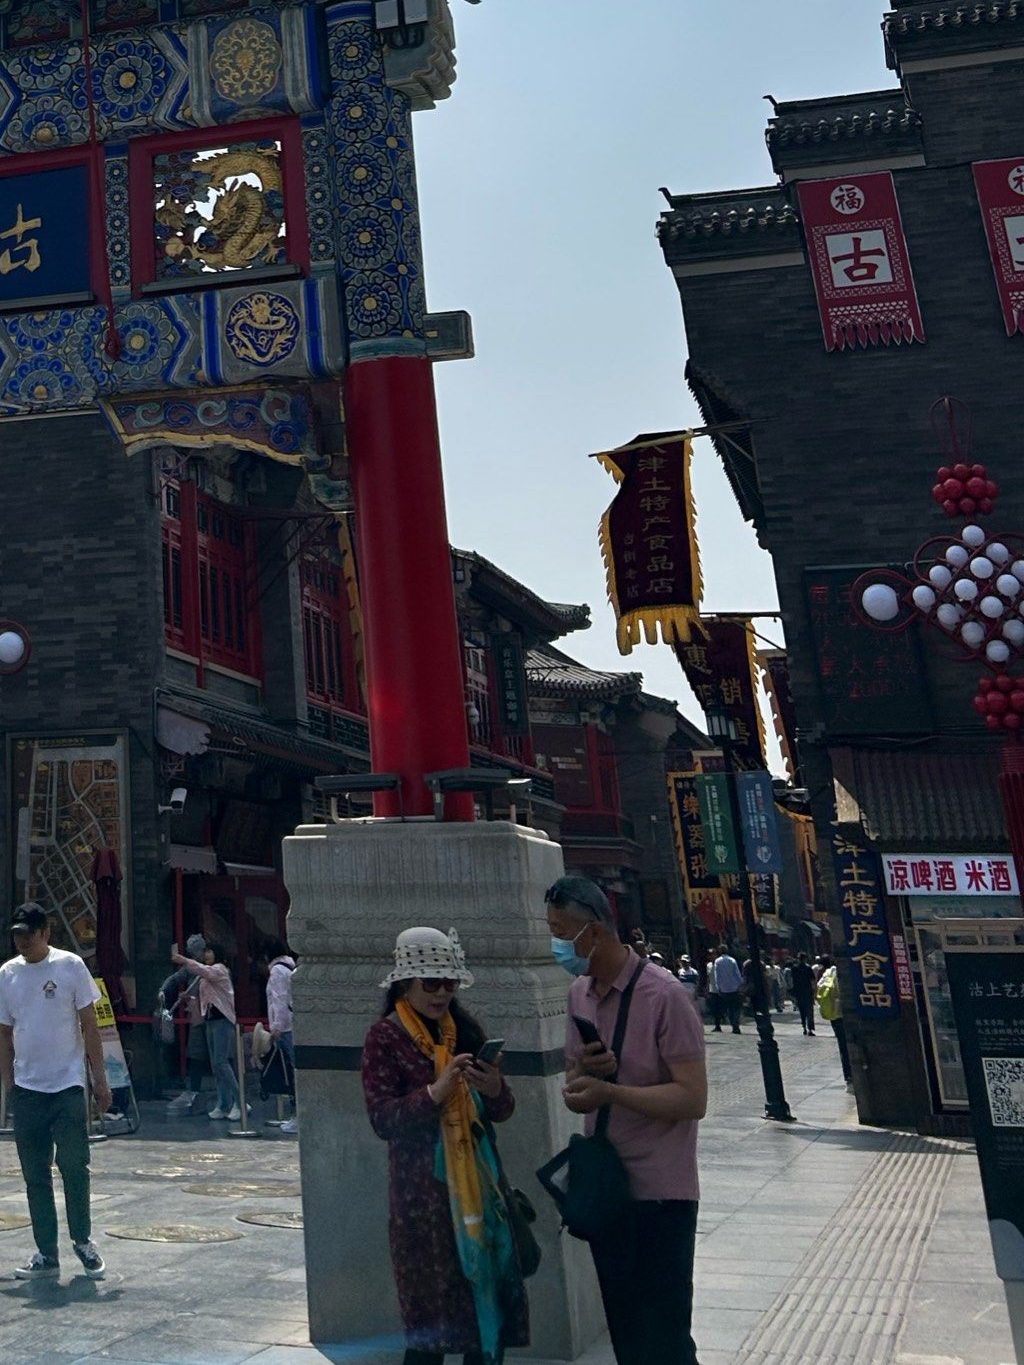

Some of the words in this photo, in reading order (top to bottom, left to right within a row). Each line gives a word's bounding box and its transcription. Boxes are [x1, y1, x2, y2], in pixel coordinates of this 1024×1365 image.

[835, 186, 862, 210] 福
[831, 237, 885, 282] 古
[887, 860, 957, 891] 凉啤酒
[965, 860, 1012, 891] 米酒
[832, 819, 892, 1008] 津土特产食品
